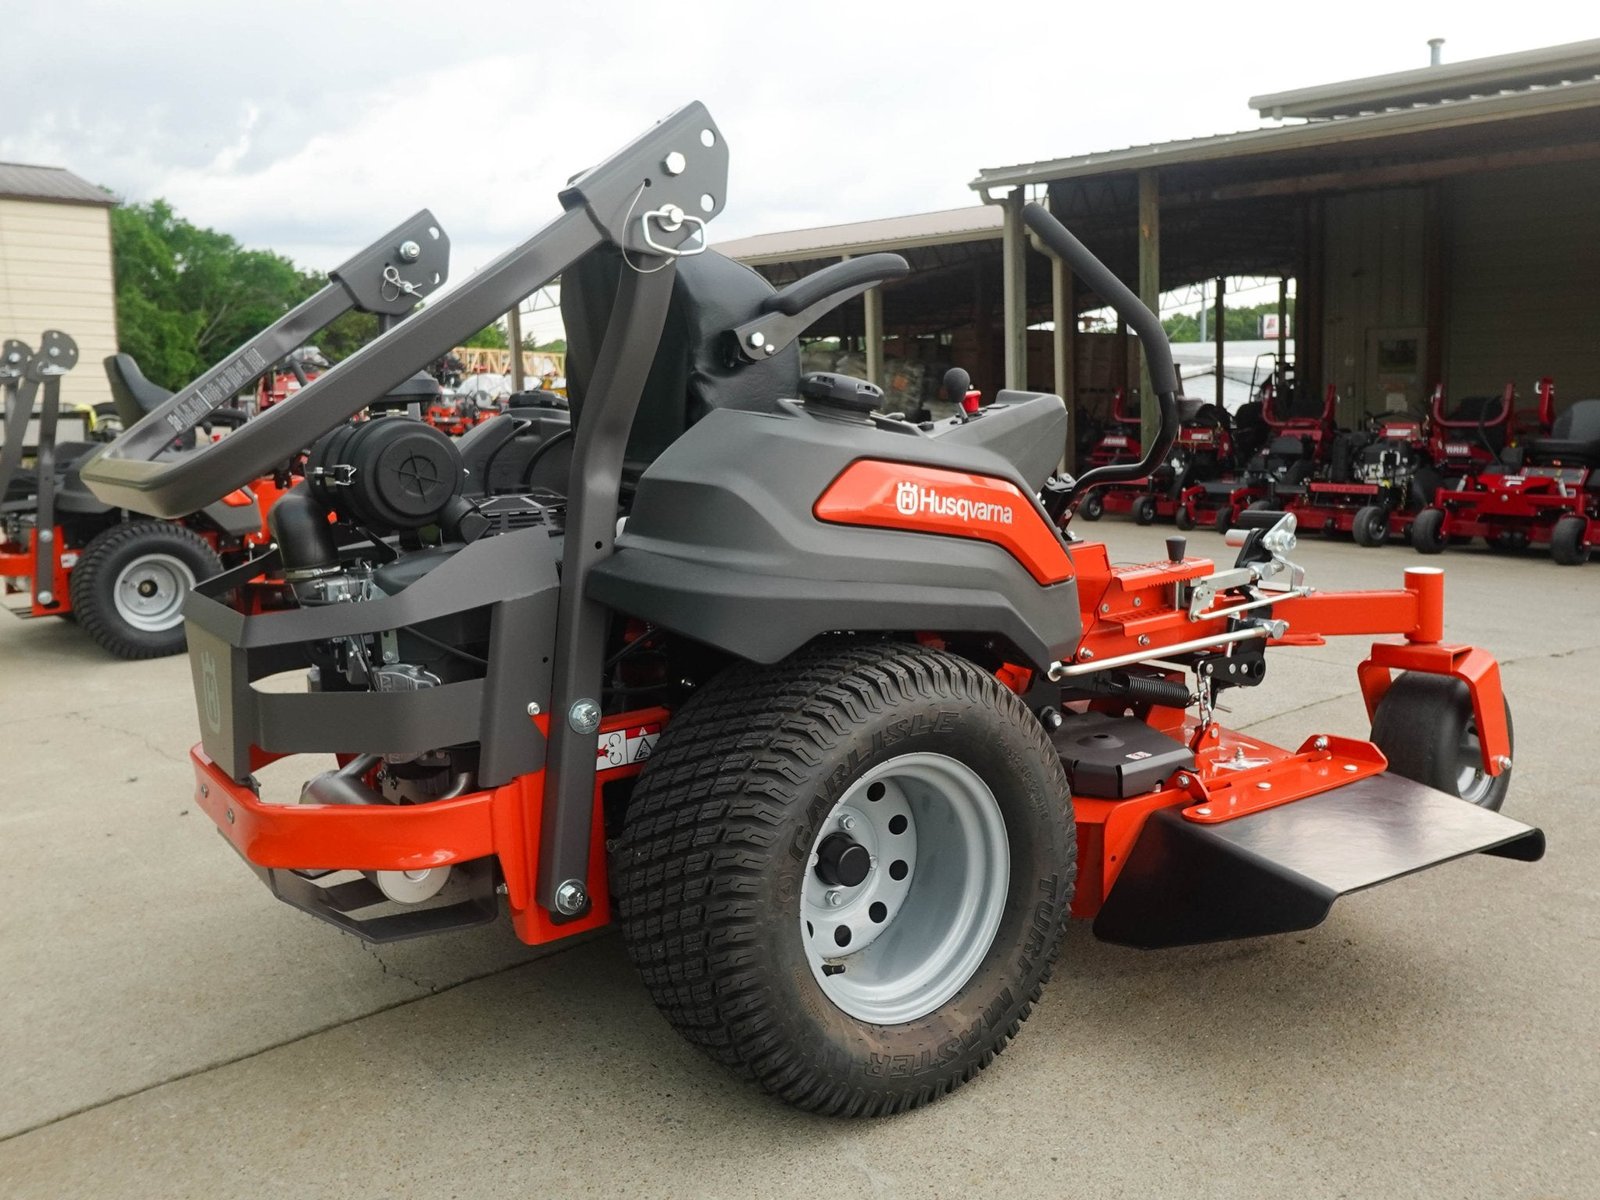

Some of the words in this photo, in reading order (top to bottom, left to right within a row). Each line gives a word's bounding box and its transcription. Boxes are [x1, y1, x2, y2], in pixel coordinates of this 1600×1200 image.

[919, 488, 1012, 524] Husqvarna
[789, 709, 960, 862] CARLISLE
[1019, 872, 1059, 974] TURF
[864, 987, 1014, 1079] MASTER
